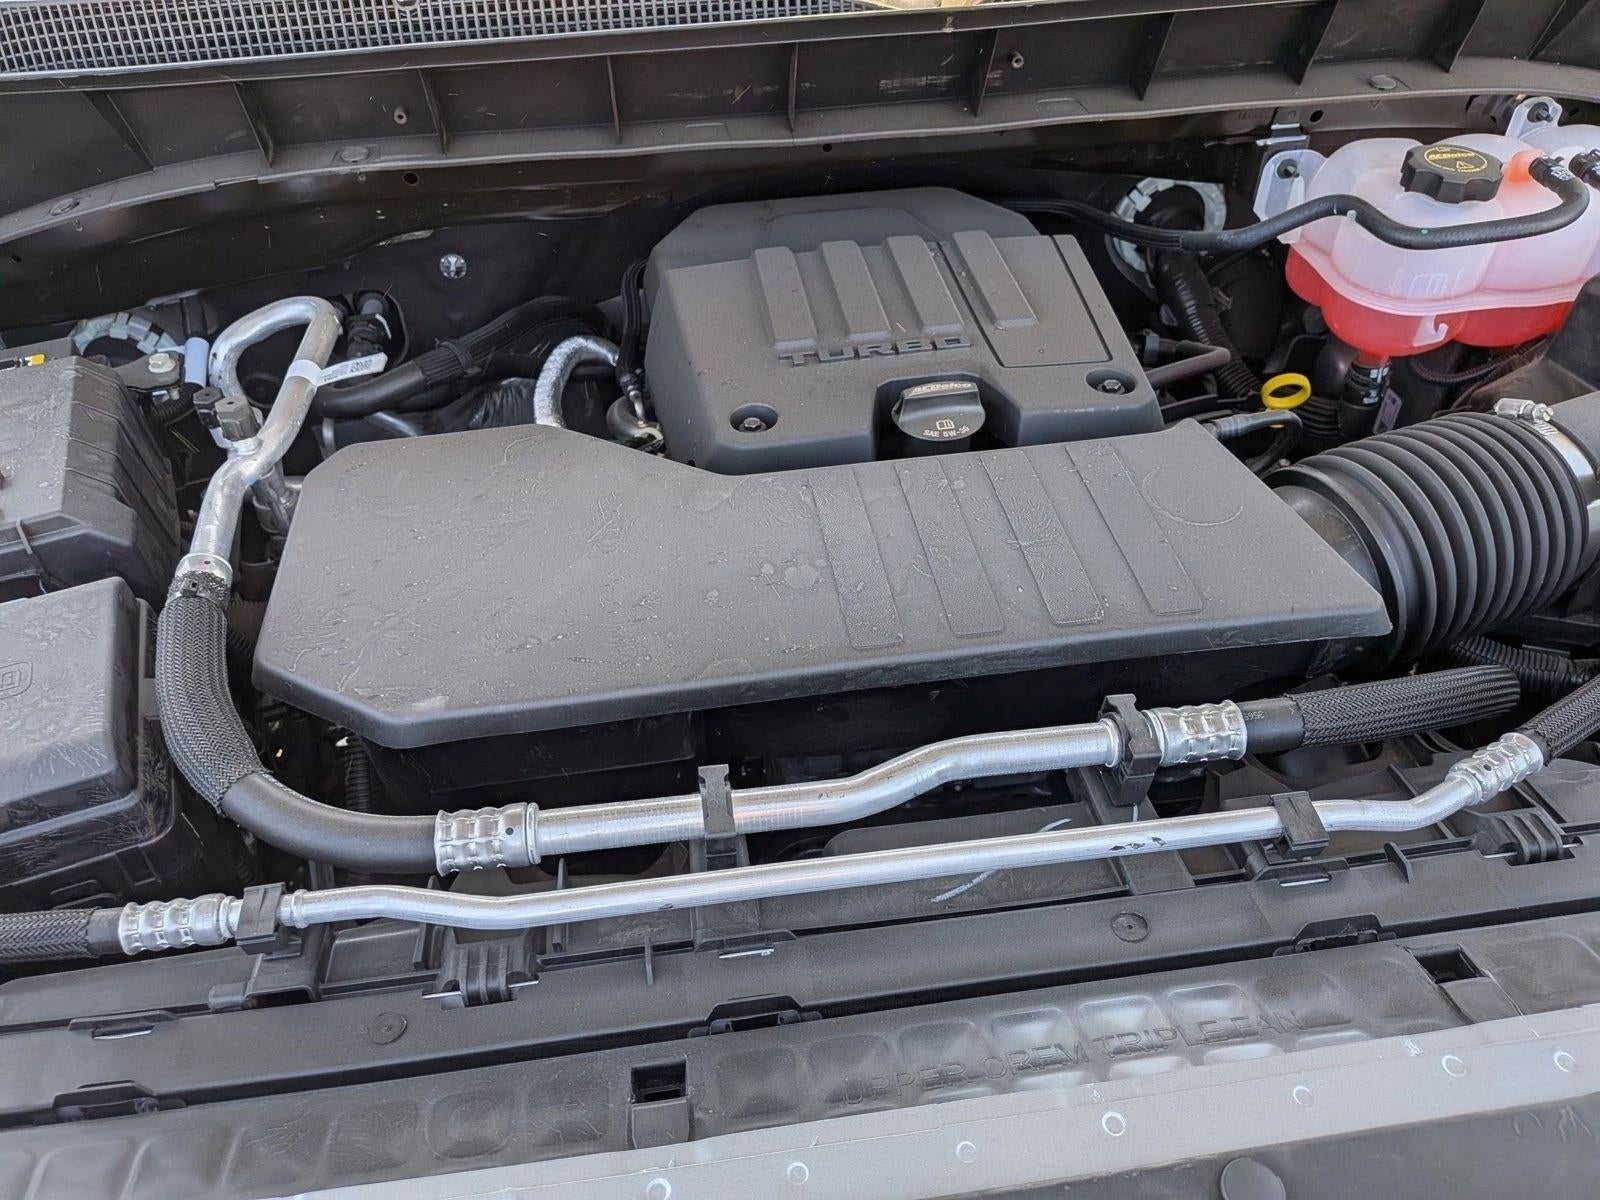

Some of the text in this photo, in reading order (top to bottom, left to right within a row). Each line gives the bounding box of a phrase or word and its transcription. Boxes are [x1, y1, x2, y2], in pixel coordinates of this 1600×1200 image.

[779, 336, 971, 367] TURBO
[908, 382, 972, 396] ACDelco
[922, 425, 971, 438] SAE 5W-30
[840, 1061, 972, 1106] UPPER
[1093, 1020, 1227, 1059] TRIPLE
[1229, 1008, 1305, 1039] FAN
